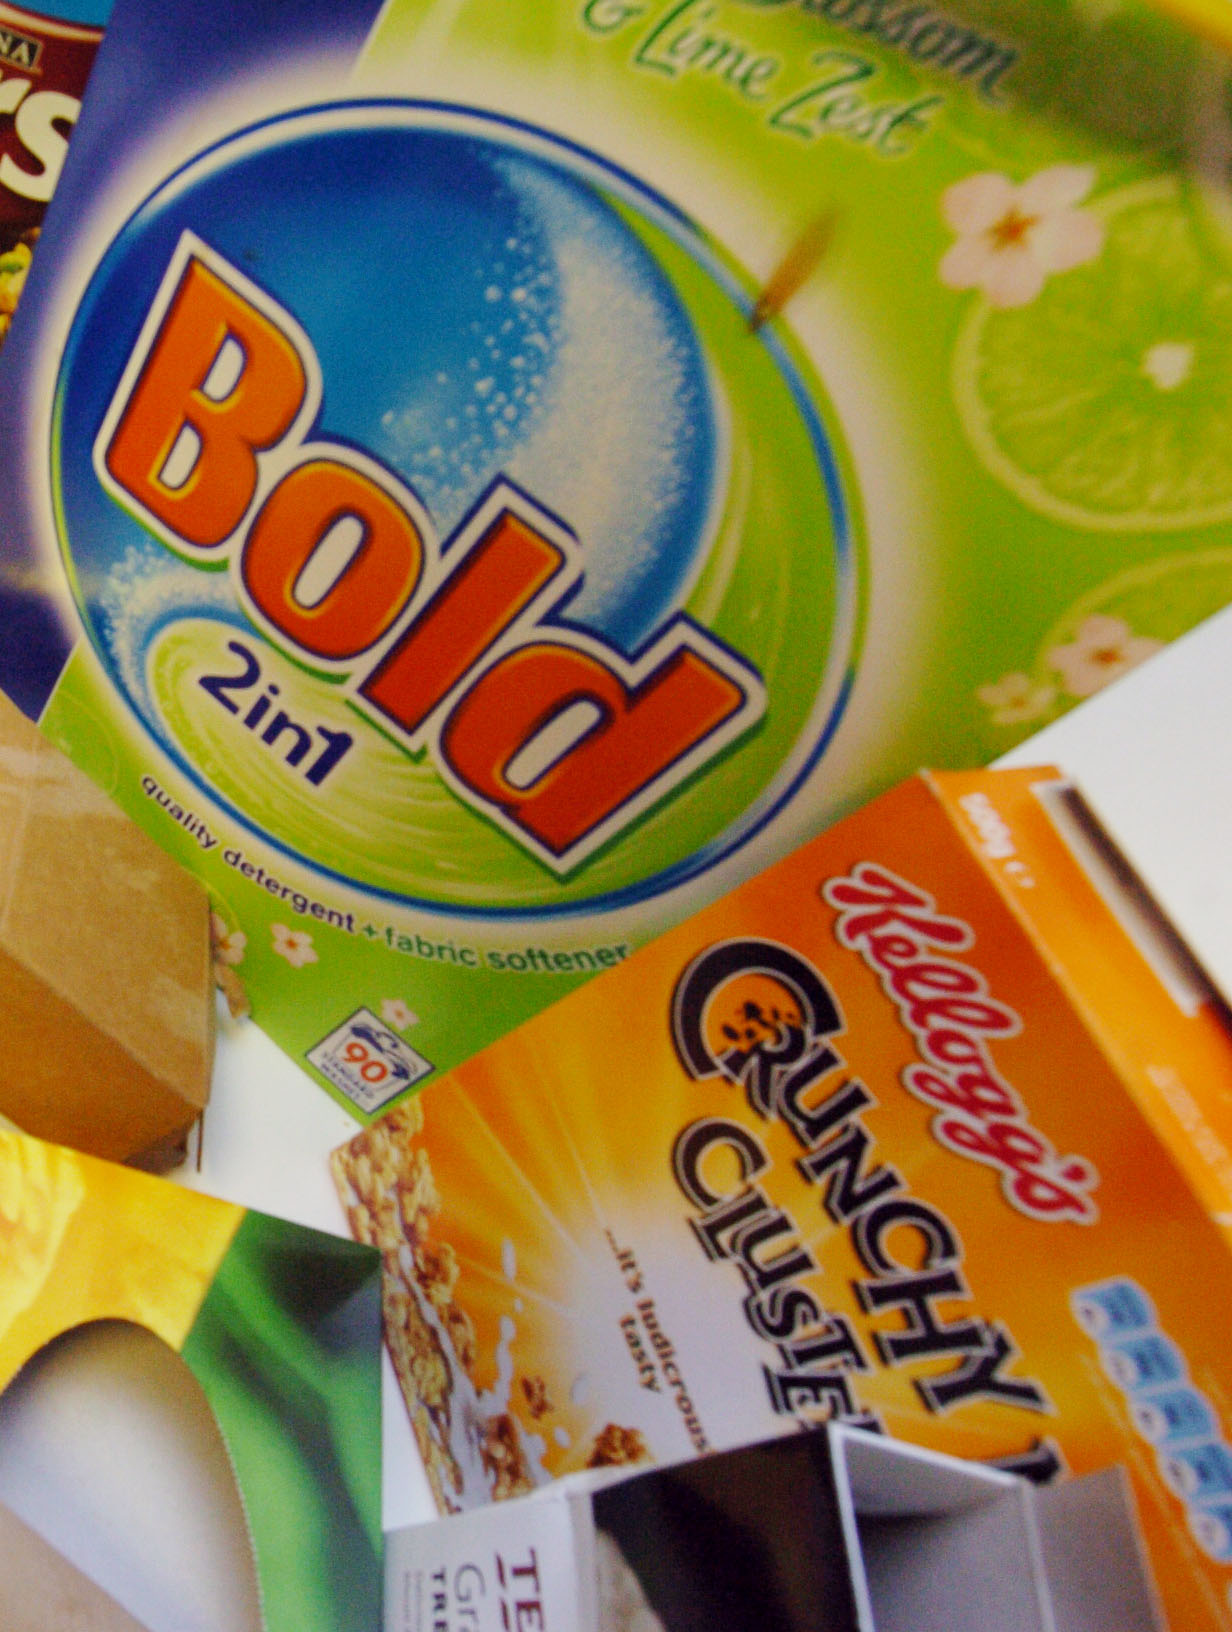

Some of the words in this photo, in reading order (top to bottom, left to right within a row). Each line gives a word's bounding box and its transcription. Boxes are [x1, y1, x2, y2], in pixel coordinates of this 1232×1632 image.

[636, 0, 777, 99] Lime
[770, 50, 946, 157] Zest
[93, 228, 768, 880] Bold
[198, 639, 356, 787] 2in1
[141, 775, 218, 850] quality
[222, 846, 358, 934] detergent
[385, 927, 478, 968] fabric
[487, 942, 630, 973] softener
[342, 1041, 388, 1083] 90
[824, 862, 1100, 1226] Kellogg's
[671, 936, 1058, 1416] CRUNCHY
[620, 1313, 662, 1393] tasty
[672, 1117, 886, 1434] CLUSTE
[454, 1562, 486, 1632] Gr
